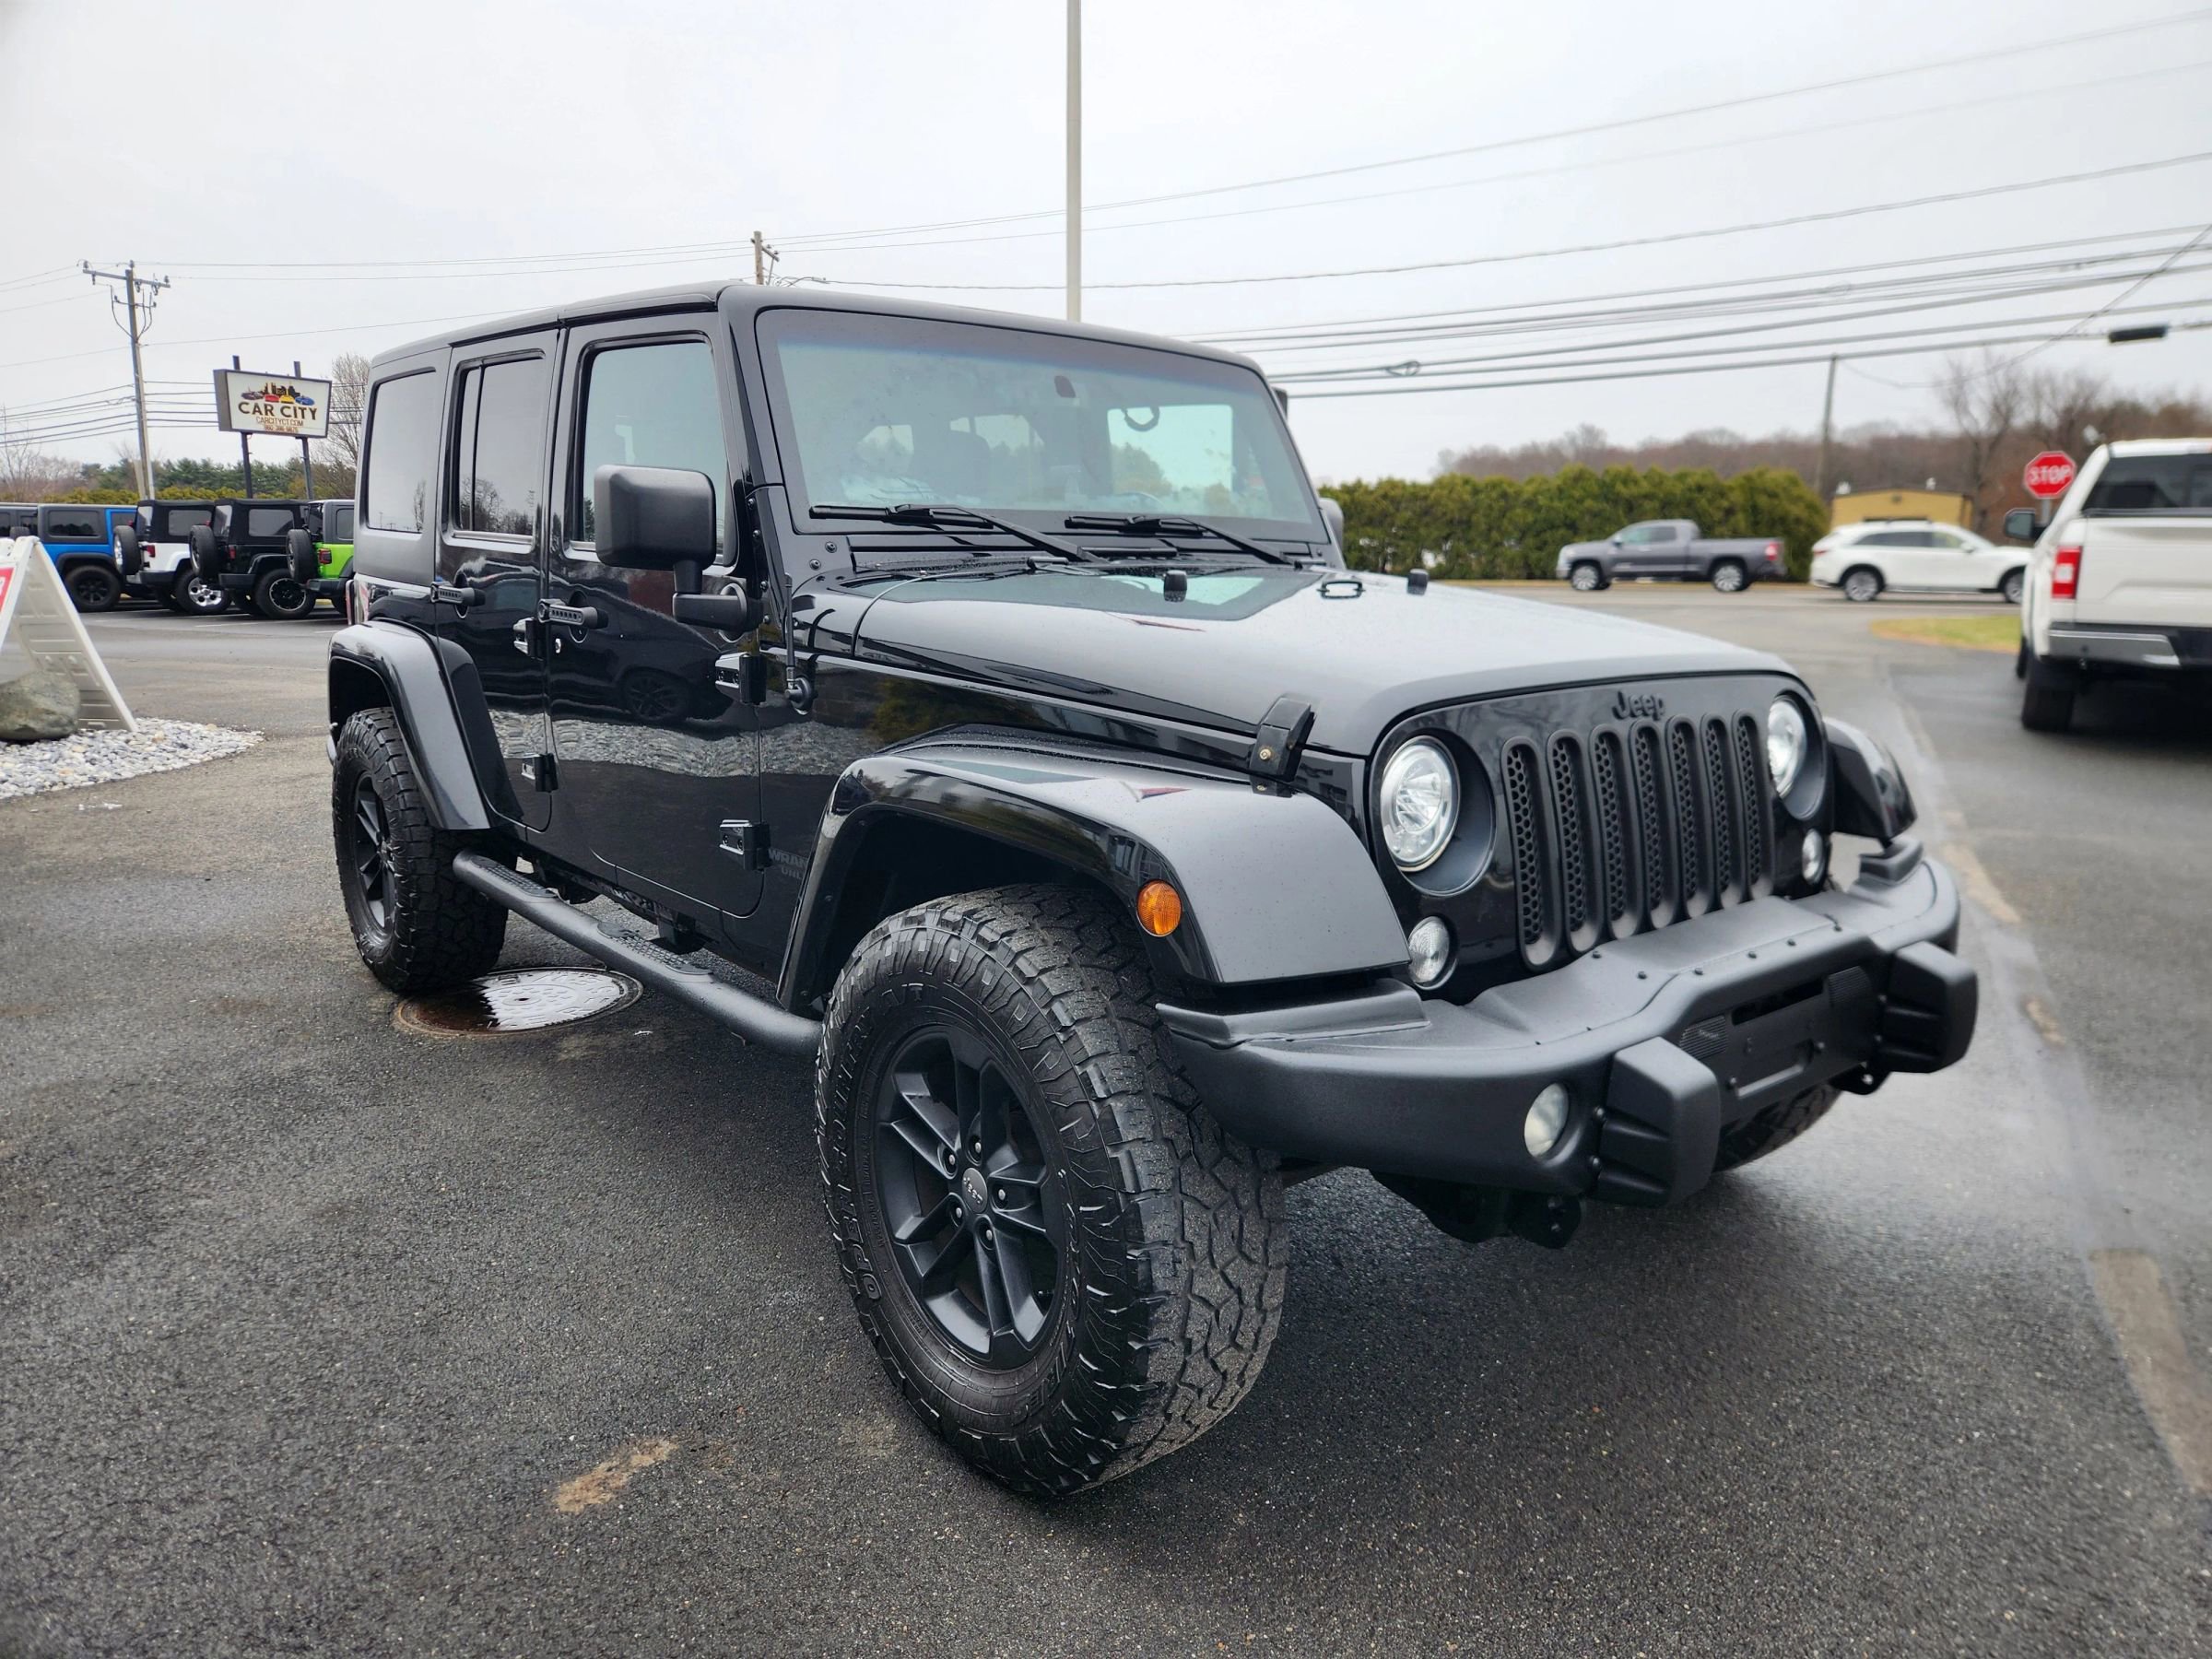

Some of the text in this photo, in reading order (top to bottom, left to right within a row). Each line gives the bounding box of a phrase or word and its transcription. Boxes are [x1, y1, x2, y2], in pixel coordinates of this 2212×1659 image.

[238, 402, 318, 420] CAR CITY
[2027, 465, 2072, 486] STOP
[1611, 690, 1665, 722] Jeep
